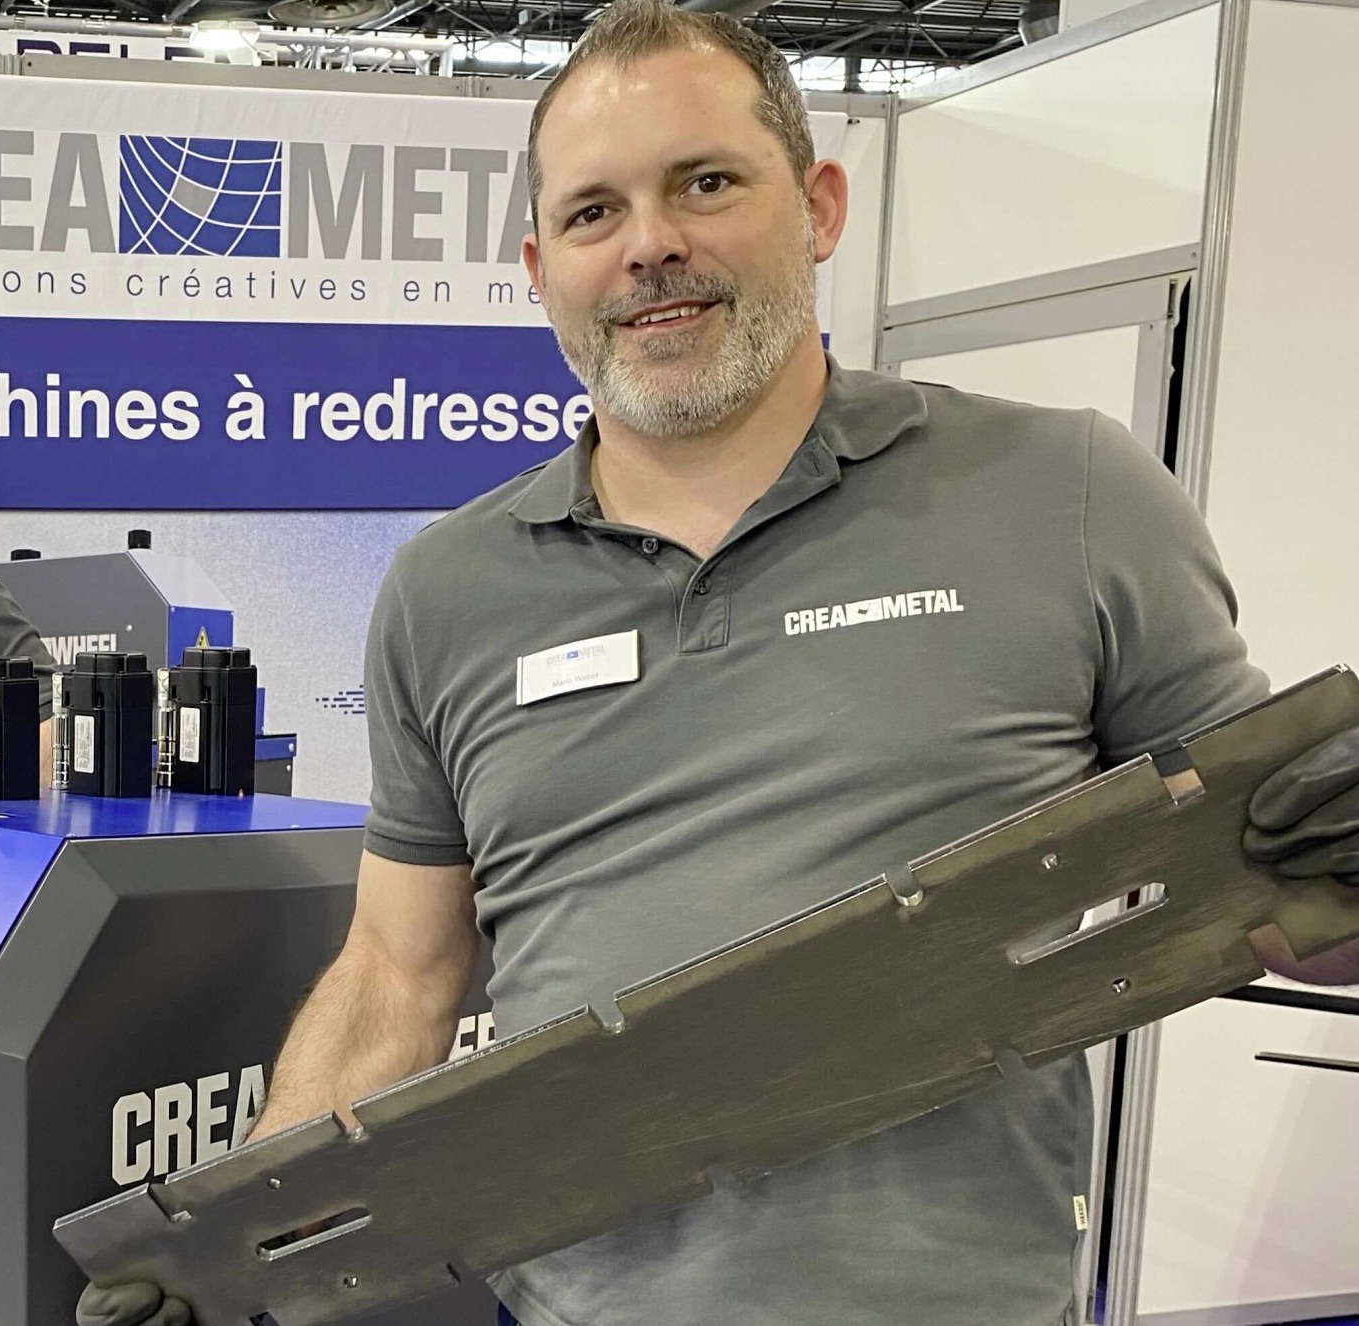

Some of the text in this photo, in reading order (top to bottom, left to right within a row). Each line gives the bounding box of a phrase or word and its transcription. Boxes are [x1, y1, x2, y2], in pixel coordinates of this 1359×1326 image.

[126, 268, 367, 301] créatives
[403, 280, 451, 303] en
[227, 373, 266, 441] à
[293, 378, 594, 444] redresse
[784, 588, 964, 636] CREA METAL
[112, 1064, 268, 1187] CREA
